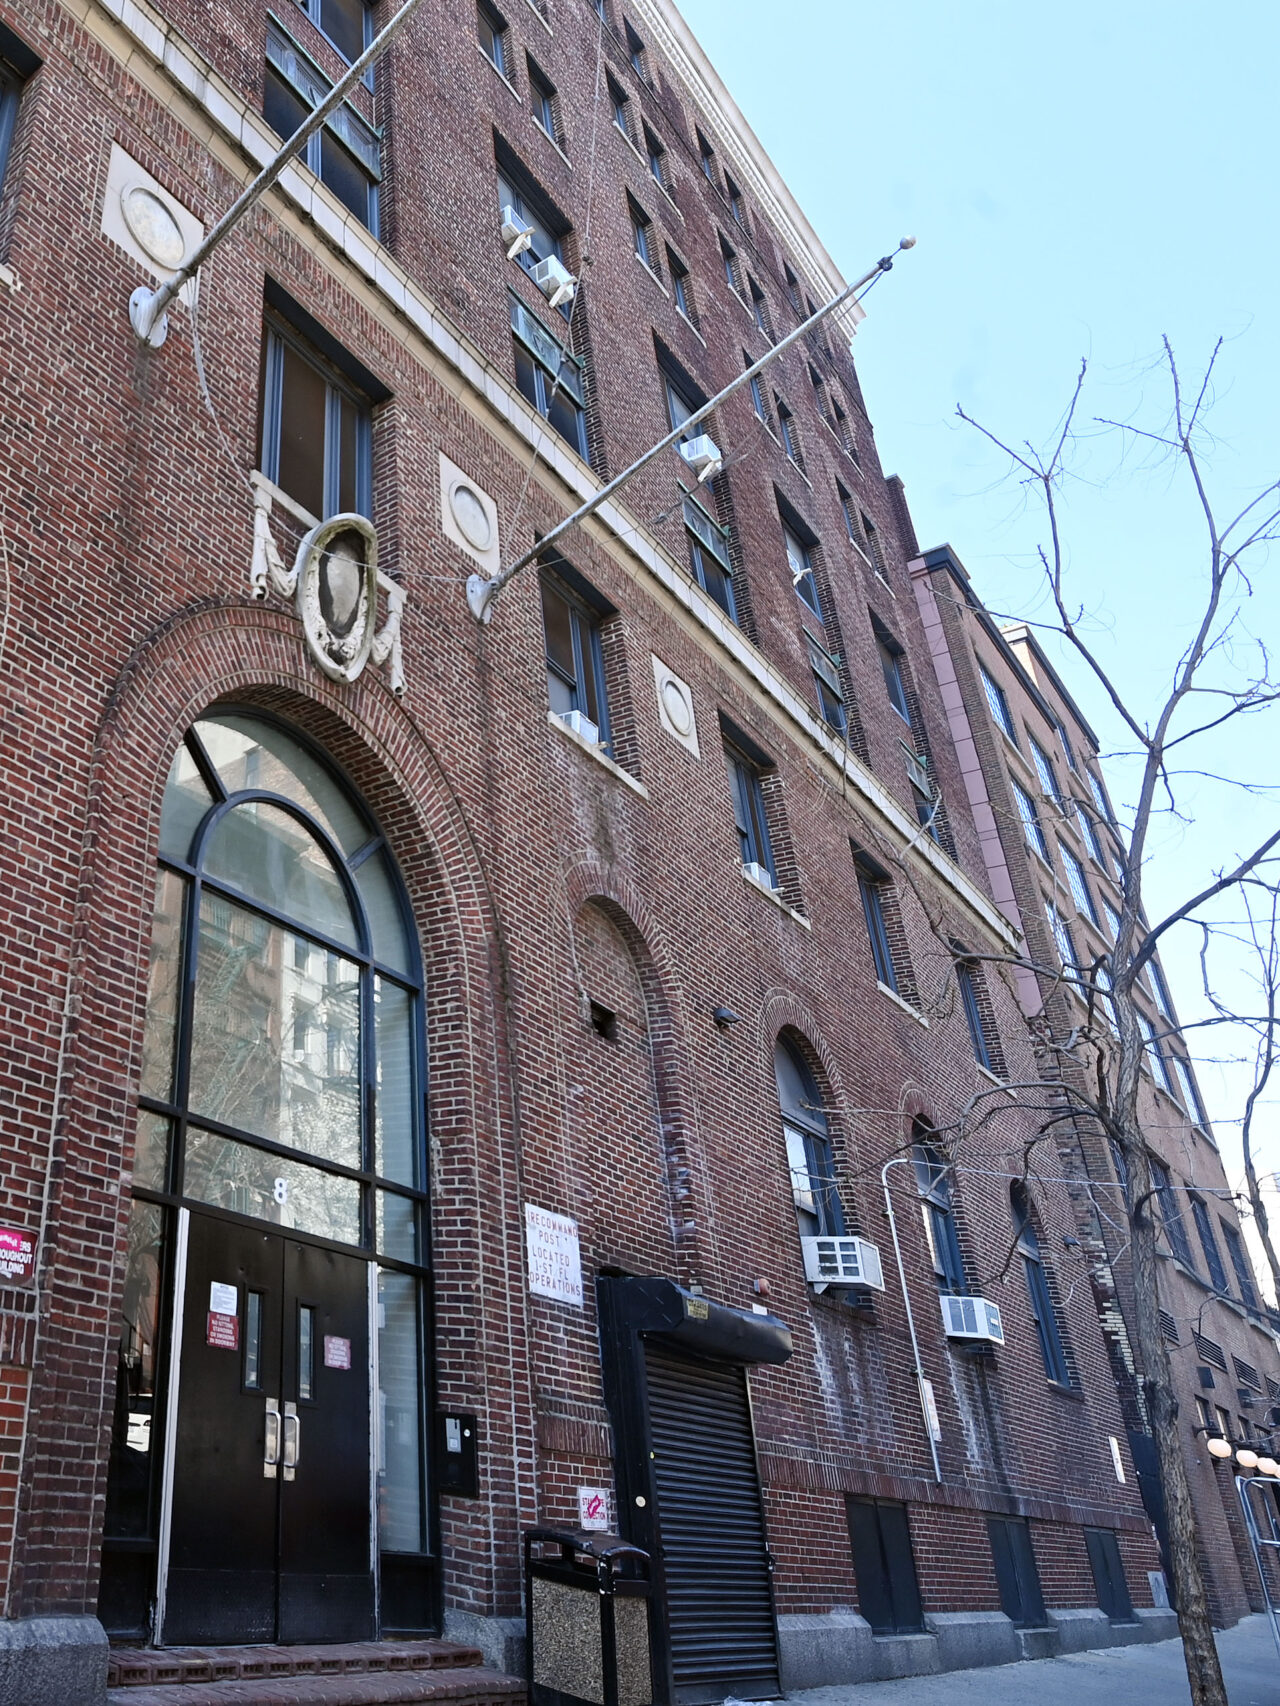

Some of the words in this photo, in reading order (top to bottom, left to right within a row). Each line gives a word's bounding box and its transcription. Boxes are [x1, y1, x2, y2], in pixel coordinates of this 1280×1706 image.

[274, 1177, 287, 1205] 8
[539, 1230, 560, 1248] POST
[532, 1244, 570, 1267] LOCATED
[529, 1271, 581, 1297] OPERATIONS
[559, 1267, 568, 1281] FL
